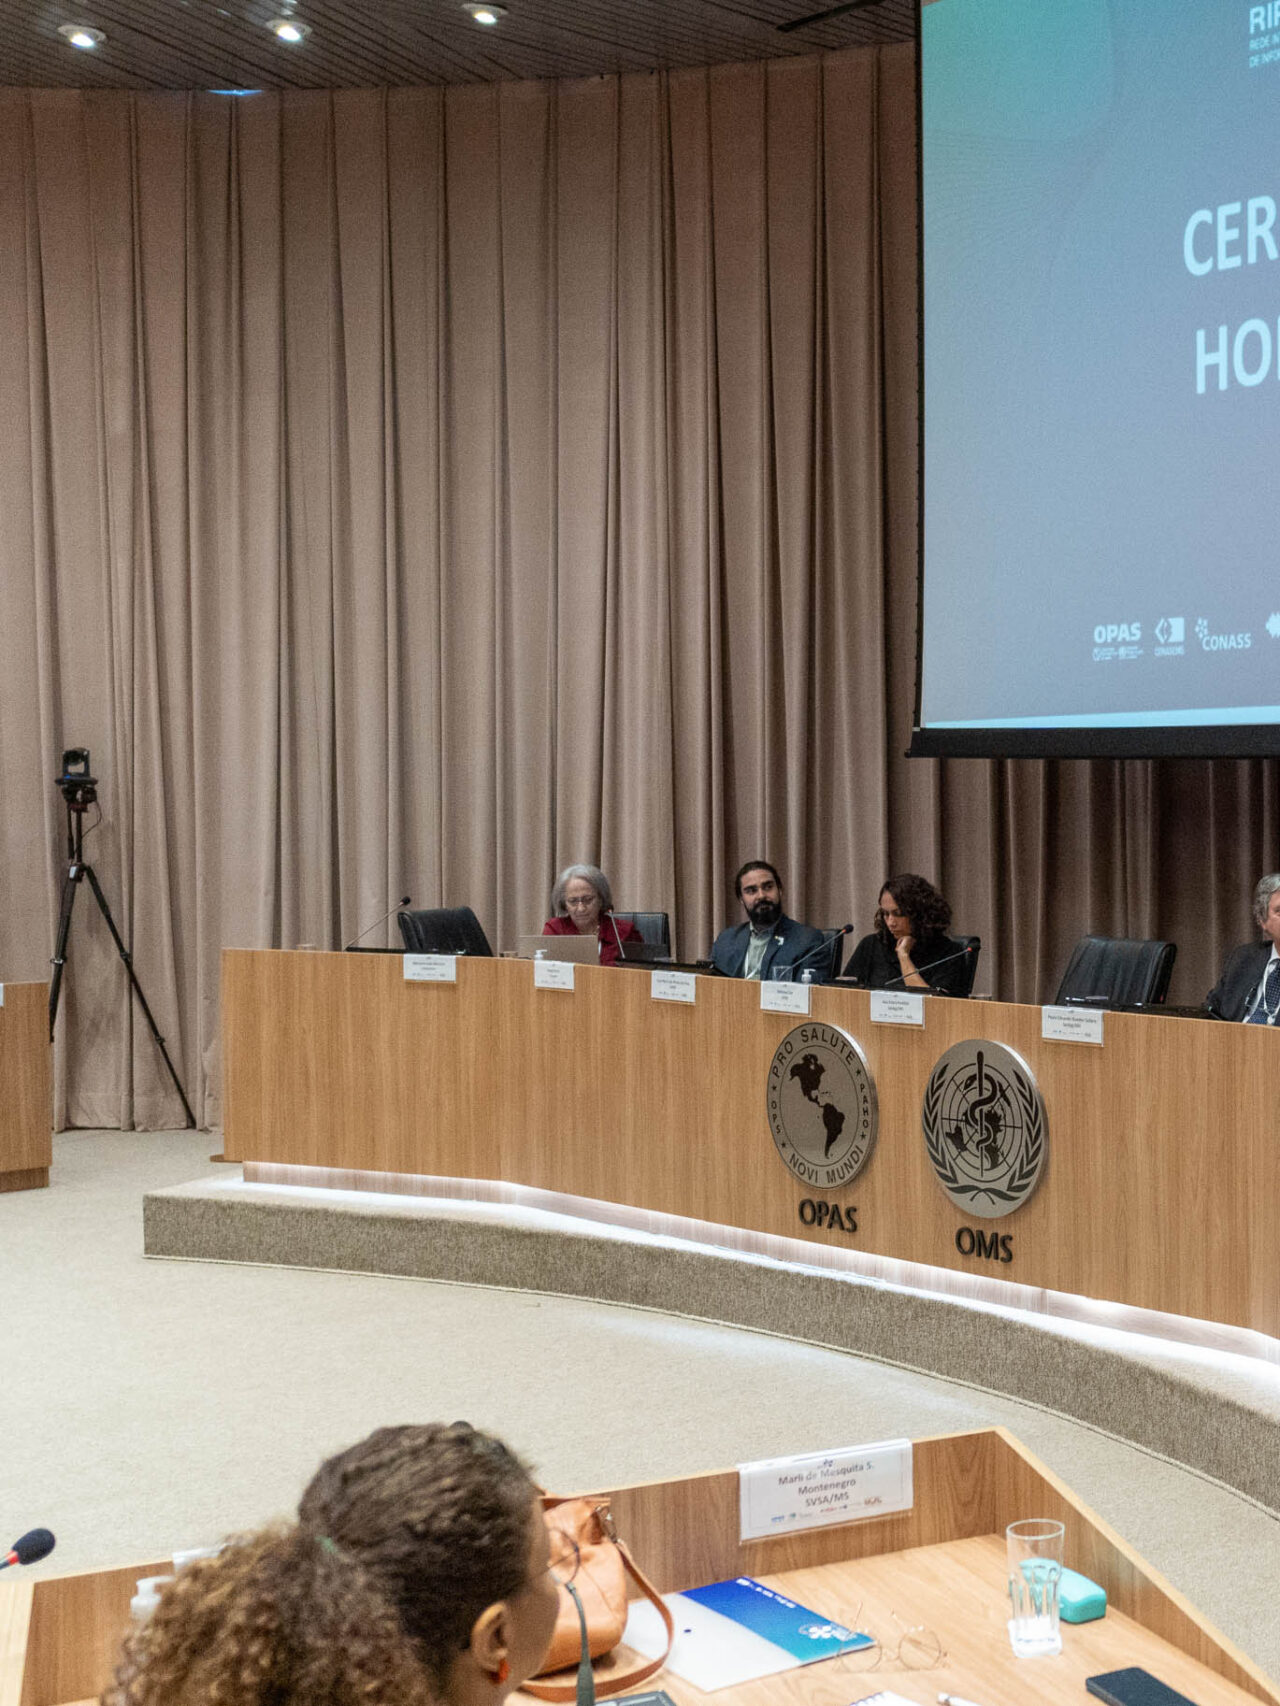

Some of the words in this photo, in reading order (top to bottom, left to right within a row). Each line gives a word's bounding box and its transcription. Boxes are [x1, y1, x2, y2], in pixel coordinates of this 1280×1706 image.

[1094, 622, 1142, 644] OPAS
[1202, 633, 1252, 651] CONASS
[772, 1040, 794, 1078] PRO
[801, 1028, 856, 1066] SALUTE
[771, 1100, 781, 1134] OPS
[859, 1083, 869, 1129] PAHO
[789, 1153, 818, 1184] NOVI
[827, 1144, 864, 1184] MUNDI
[799, 1199, 858, 1233] OPAS
[955, 1226, 1013, 1264] OMS
[778, 1475, 804, 1486] Marli
[806, 1470, 818, 1481] de
[820, 1464, 864, 1479] Mesquita
[798, 1478, 856, 1496] Montenegro
[805, 1491, 850, 1508] SVSA/MS
